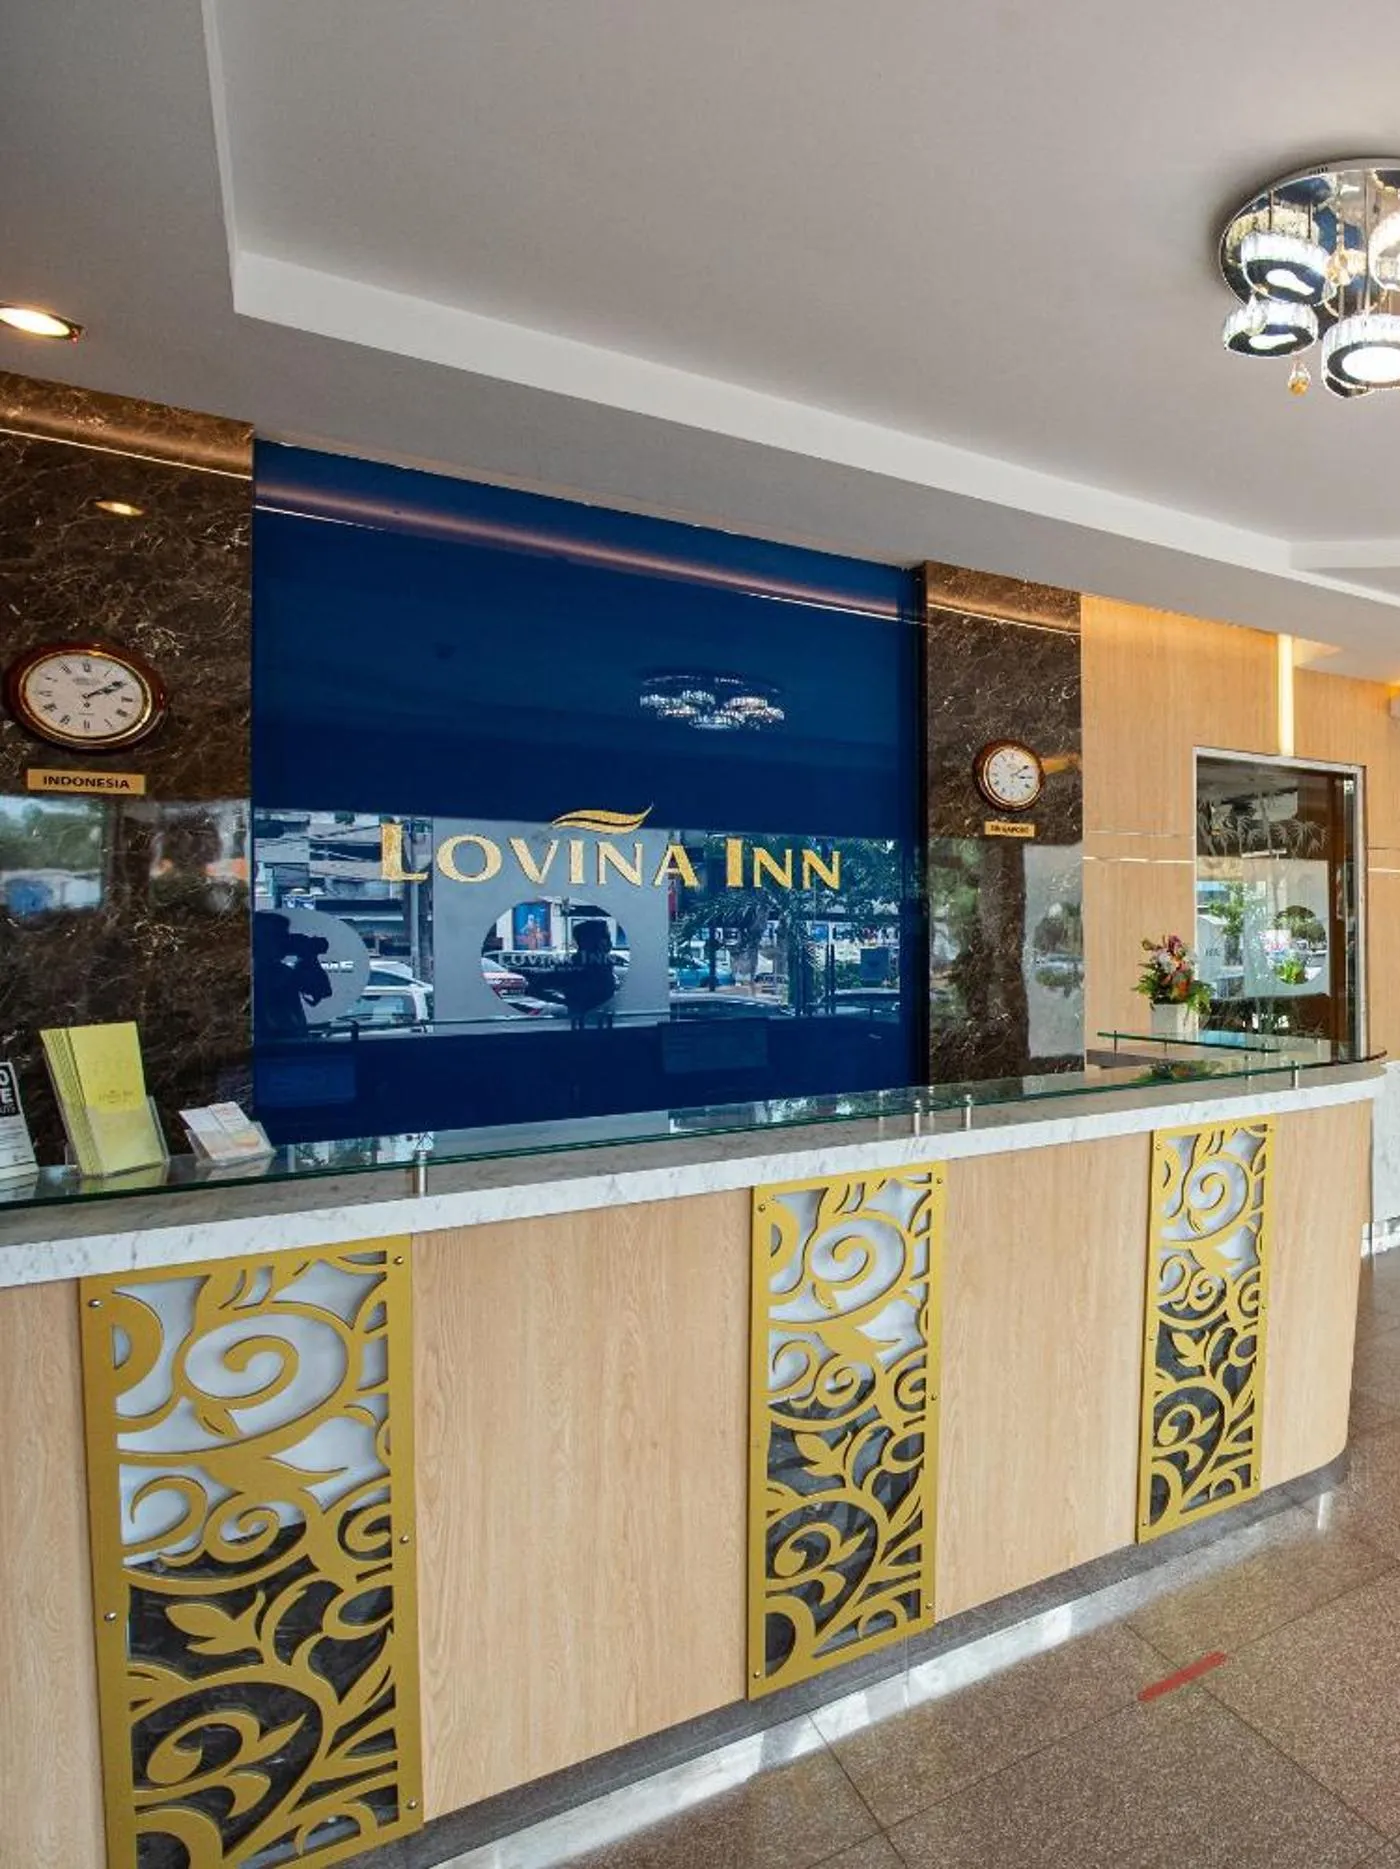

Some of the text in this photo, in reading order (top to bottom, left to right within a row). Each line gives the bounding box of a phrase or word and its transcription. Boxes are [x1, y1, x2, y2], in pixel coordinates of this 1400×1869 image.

[43, 776, 130, 789] INDONESIA
[380, 823, 841, 890] LOVINA INN
